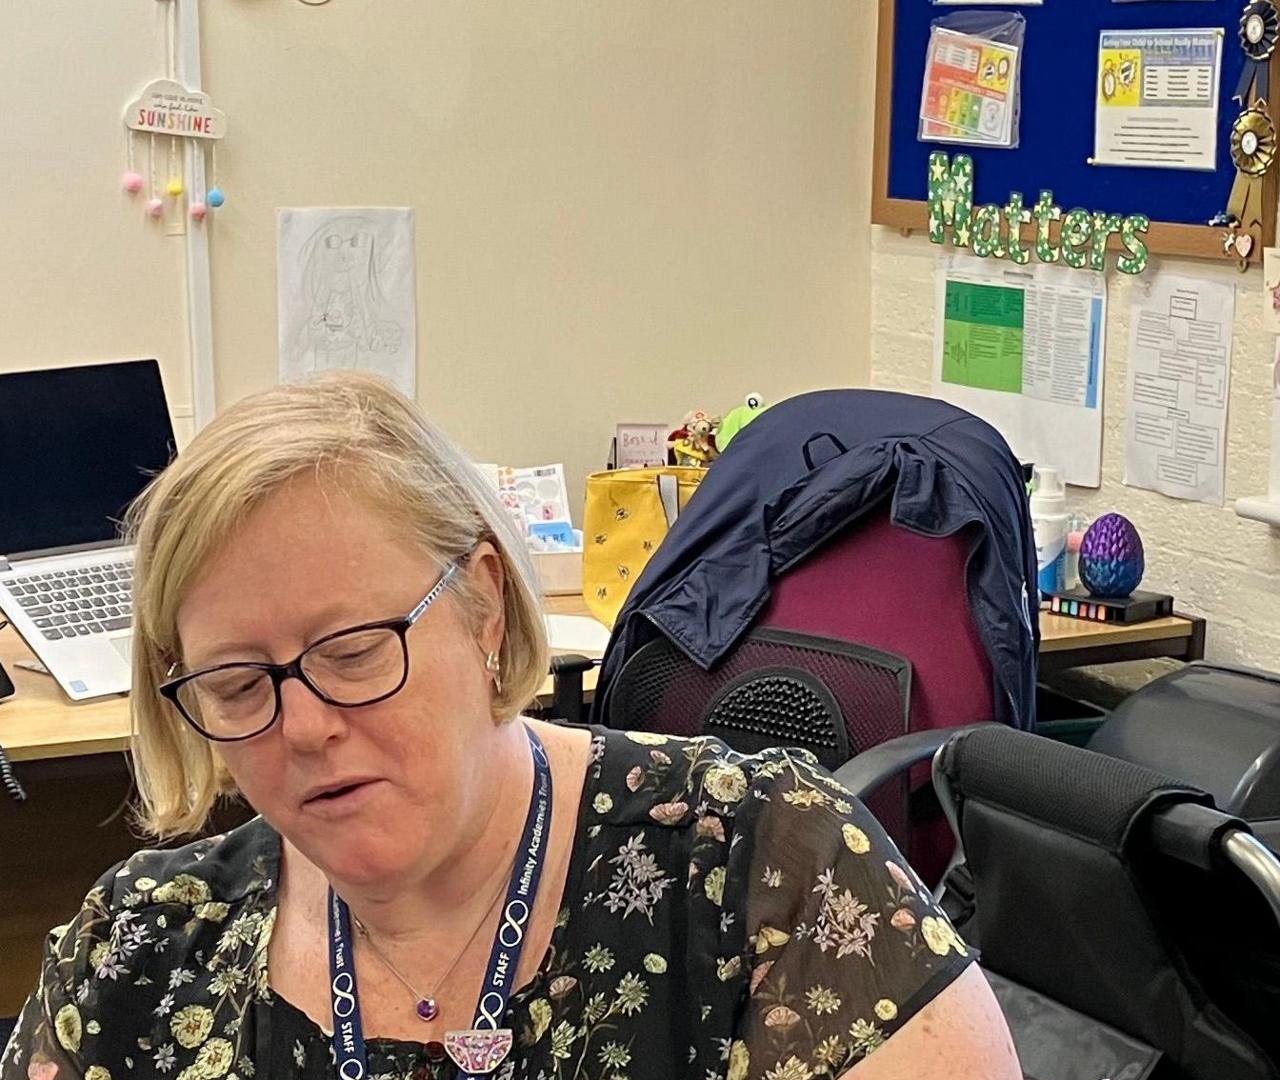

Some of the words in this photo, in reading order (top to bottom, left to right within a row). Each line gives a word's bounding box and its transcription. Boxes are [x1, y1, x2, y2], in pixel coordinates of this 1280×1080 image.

[138, 109, 212, 134] SUNSHINE
[927, 151, 1149, 274] Matters
[518, 855, 537, 896] Infinity
[528, 799, 548, 857] Academies
[538, 772, 549, 797] Trust
[493, 952, 510, 987] STAFF
[341, 1021, 355, 1053] STAFF
